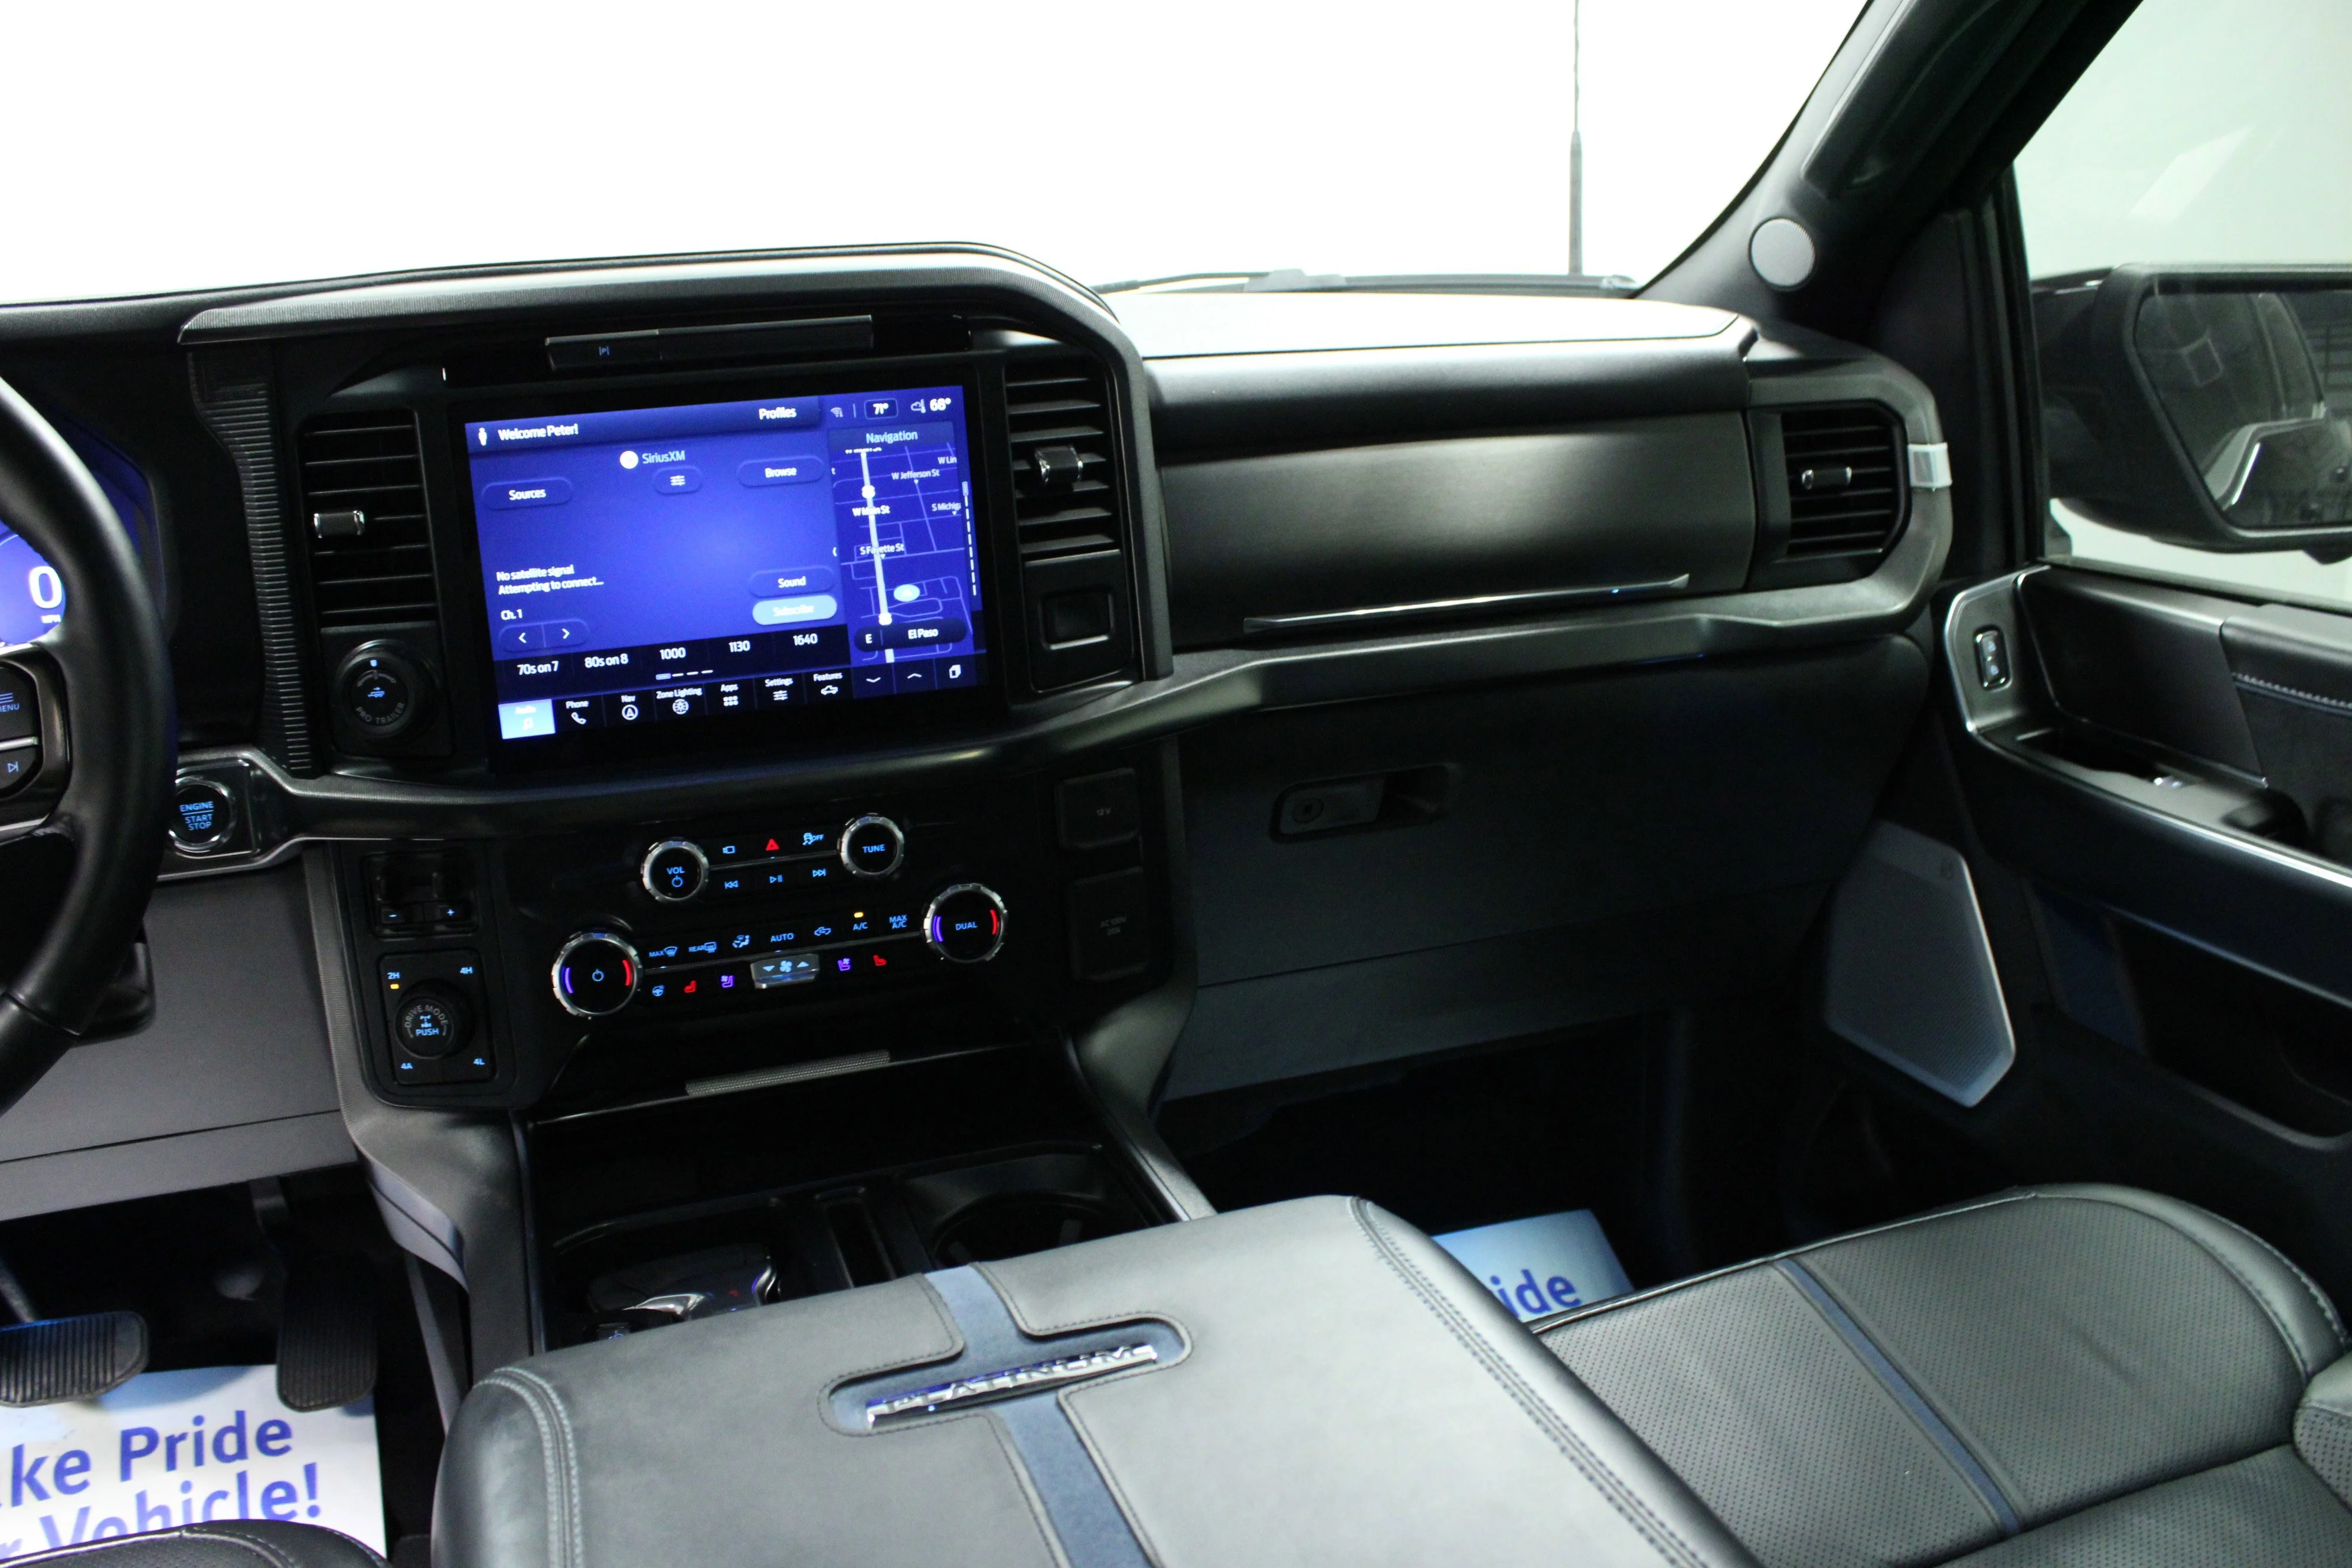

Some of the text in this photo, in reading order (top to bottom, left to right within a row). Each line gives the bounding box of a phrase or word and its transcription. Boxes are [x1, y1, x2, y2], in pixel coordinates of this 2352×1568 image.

[759, 406, 797, 420] Profiles
[498, 423, 579, 441] Welcome Peter!
[865, 430, 918, 444] Navigation
[642, 450, 685, 464] SiriusXM
[765, 467, 797, 478] Browse
[900, 469, 930, 479] Jefferson
[931, 469, 940, 477] St
[508, 488, 546, 501] Sources
[895, 543, 904, 553] St
[496, 564, 574, 582] No satellite signal
[28, 566, 62, 609] 0
[499, 576, 605, 595] Attempting to connect...
[777, 575, 806, 589] Sound
[501, 609, 517, 620] Ch.
[772, 603, 814, 617] Subscribe
[865, 633, 873, 644] E
[908, 628, 939, 639] El Paso
[793, 633, 818, 646] 1640
[729, 640, 751, 653] 1130
[659, 647, 686, 660] 1000
[584, 653, 629, 668] 80s on 8
[517, 661, 559, 675] 70s on 7
[813, 671, 843, 681] Features
[720, 683, 739, 692] Apps
[765, 676, 793, 688] Settings
[656, 687, 702, 700] Zone Lighting
[566, 700, 589, 710] Phone
[355, 701, 406, 725] PRO TRAILER
[179, 801, 214, 812] ENGINE
[184, 812, 213, 824] START
[188, 821, 213, 831] STOP
[812, 833, 825, 842] OFF
[862, 844, 886, 854] TUNE
[666, 866, 685, 876] VOL
[888, 914, 907, 923] MAX
[852, 922, 868, 931] A/C
[891, 920, 907, 930] A/C
[955, 921, 978, 931] DUAL
[770, 932, 794, 943] AUTO
[387, 971, 400, 979] 2H
[460, 966, 473, 975] 4H
[404, 1004, 449, 1028] DRIVE MODE
[415, 1028, 440, 1037] PUSH
[0, 1409, 293, 1508] ke Pride
